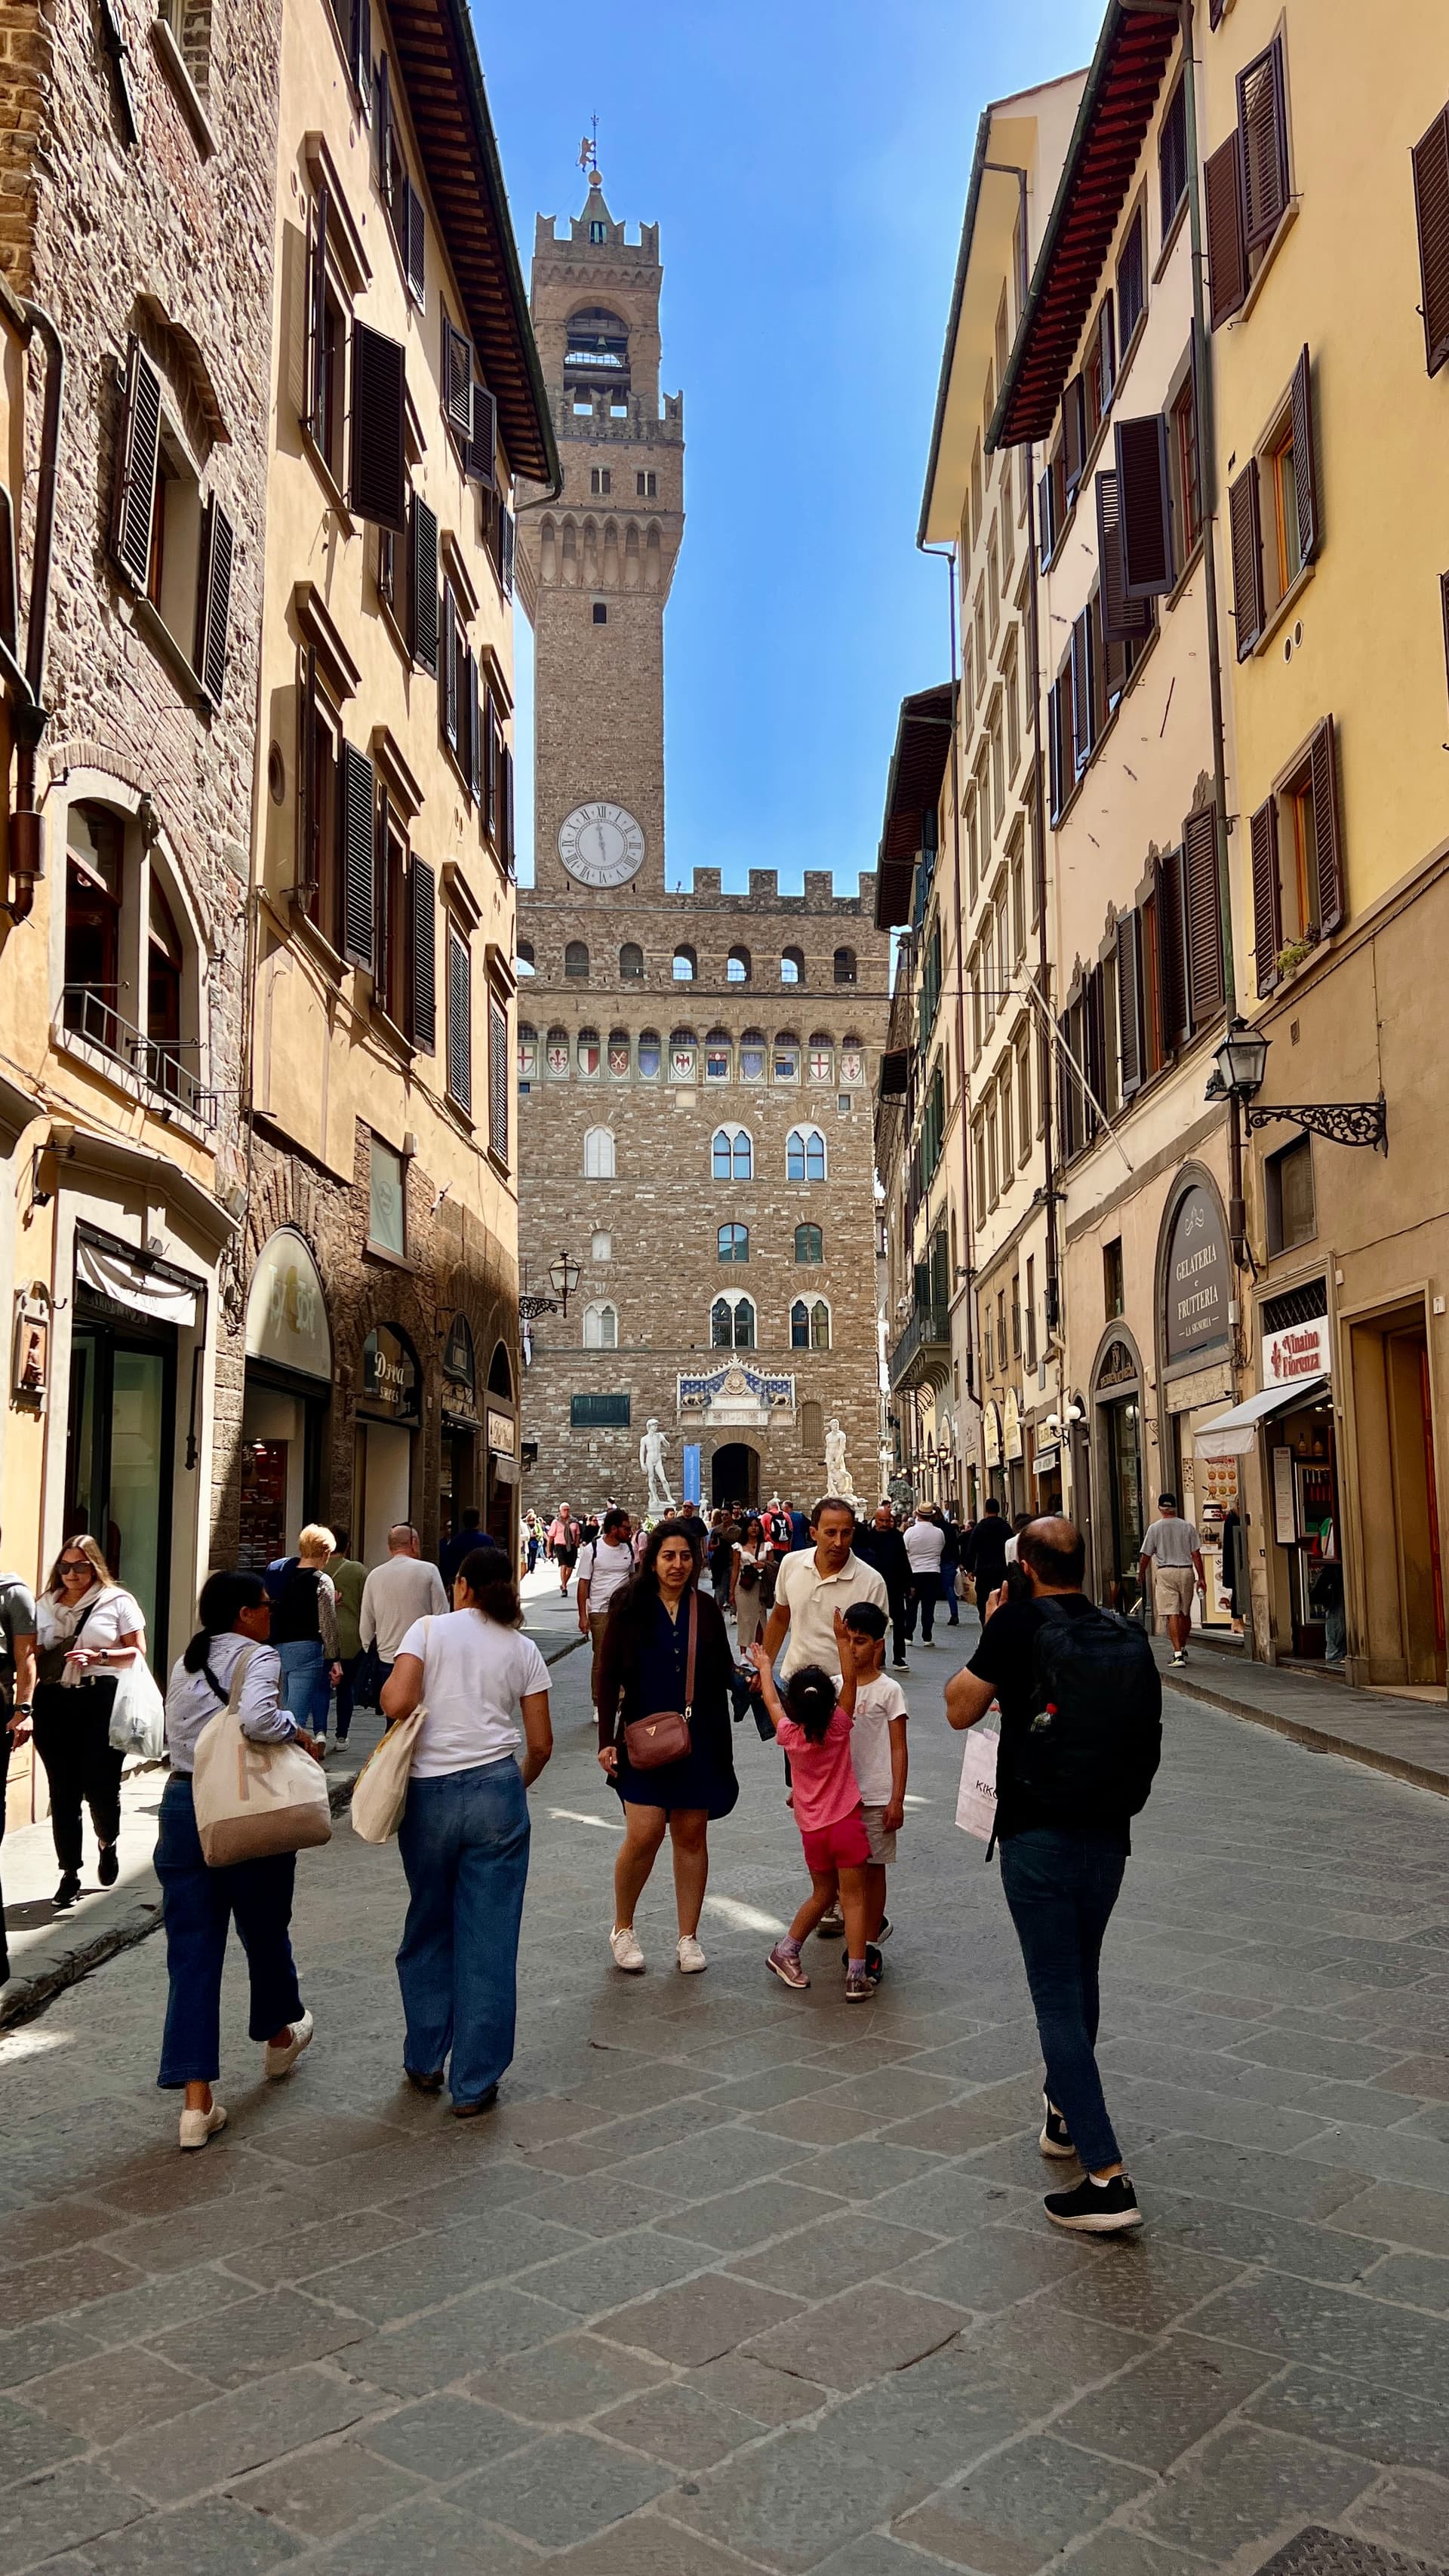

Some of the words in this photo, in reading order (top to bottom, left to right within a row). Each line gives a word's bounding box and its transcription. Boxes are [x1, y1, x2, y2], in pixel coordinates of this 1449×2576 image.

[1177, 1242, 1217, 1282] GELATERIA
[1177, 1284, 1219, 1320] FRUTTERIA
[1282, 1329, 1320, 1355] Vinaino
[1282, 1353, 1321, 1377] Fiorenza
